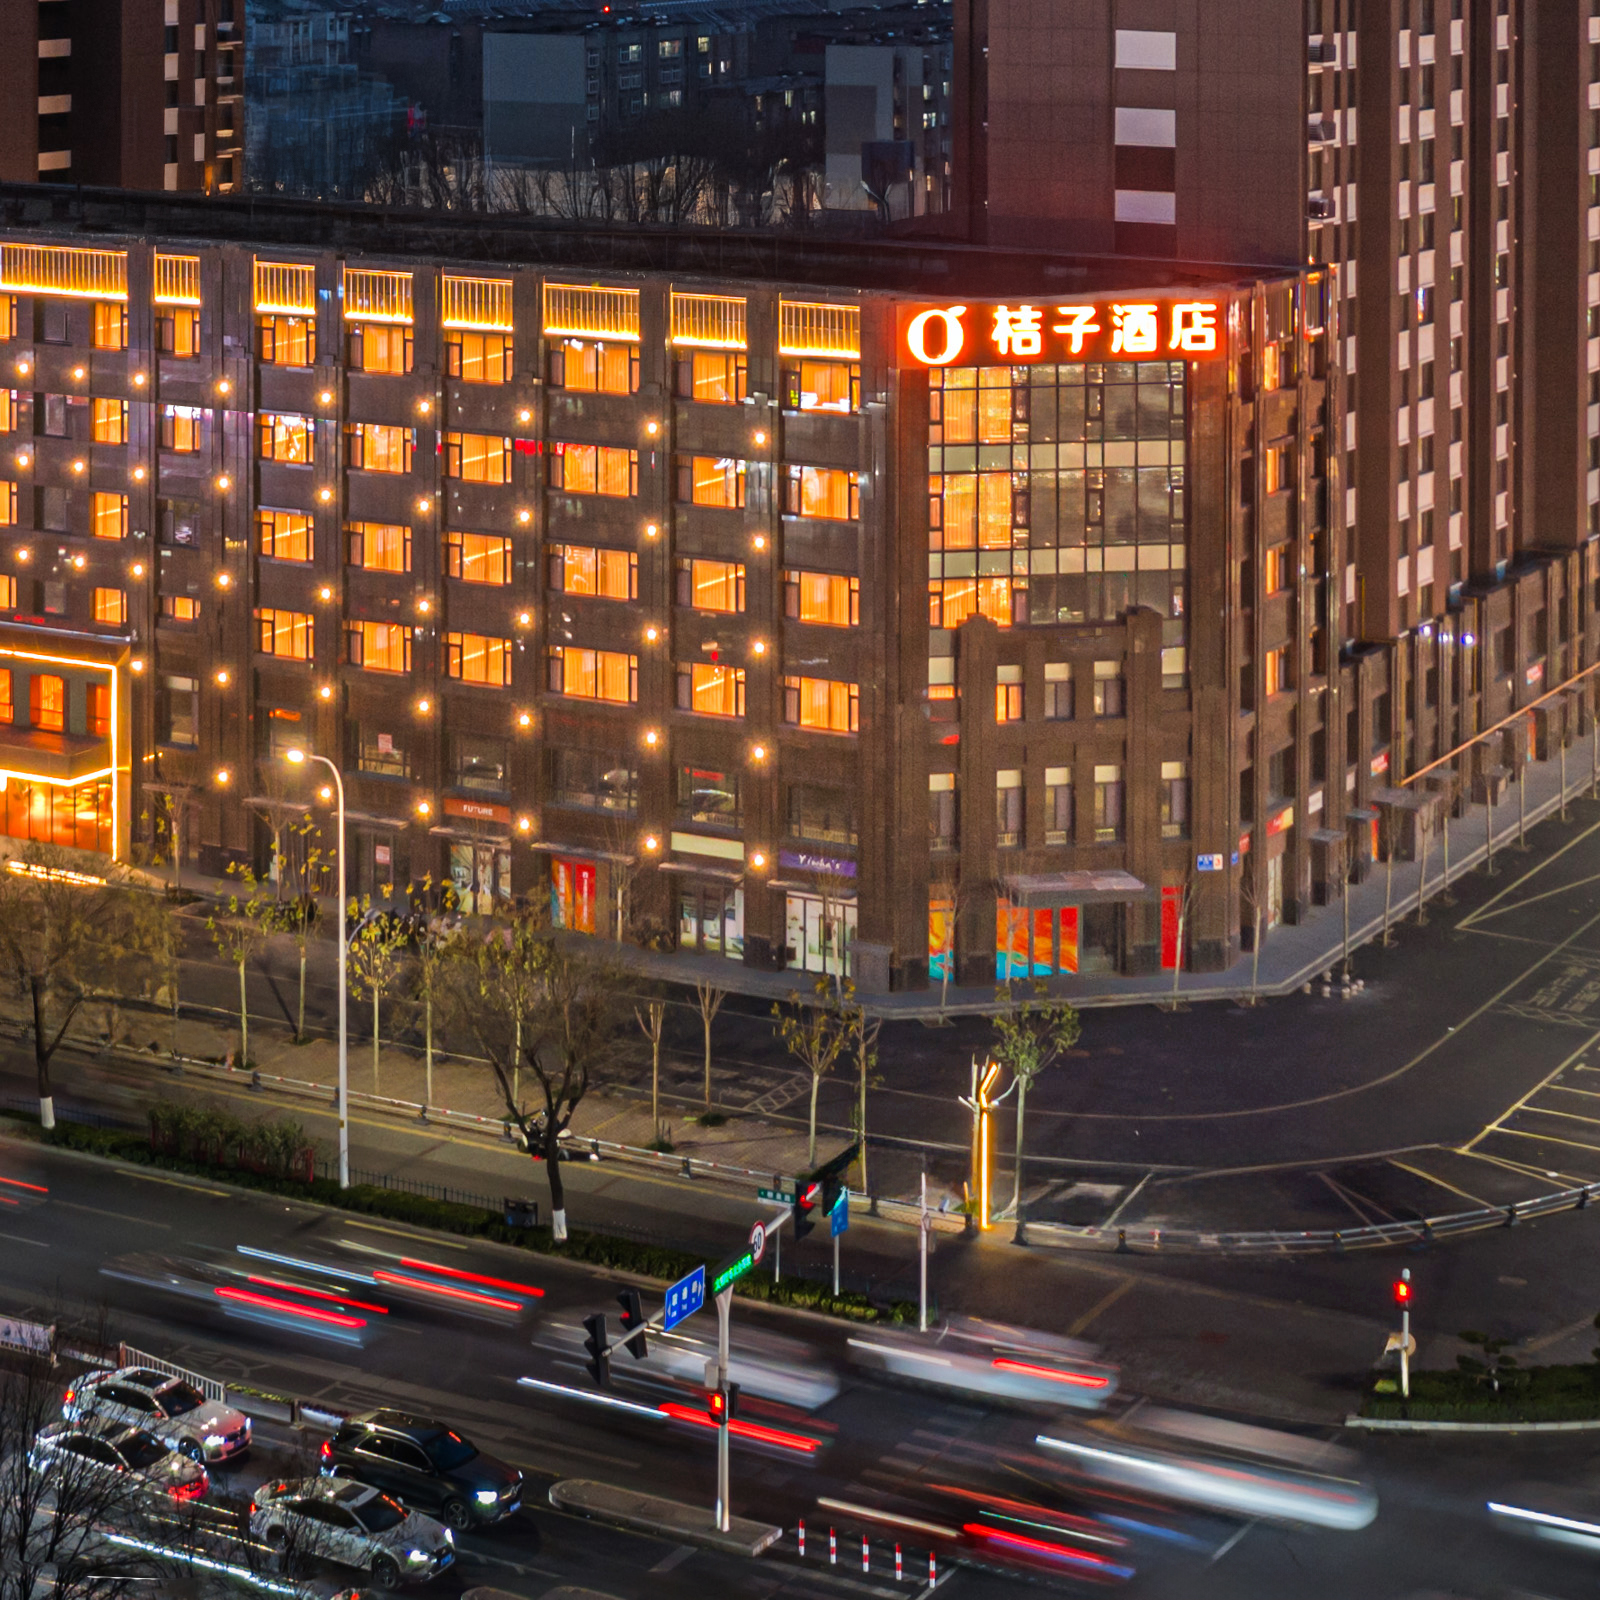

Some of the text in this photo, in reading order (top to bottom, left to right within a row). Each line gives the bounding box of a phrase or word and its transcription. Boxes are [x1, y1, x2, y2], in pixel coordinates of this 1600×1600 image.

[991, 303, 1218, 356] 桔子酒店
[463, 804, 494, 817] FUTURE
